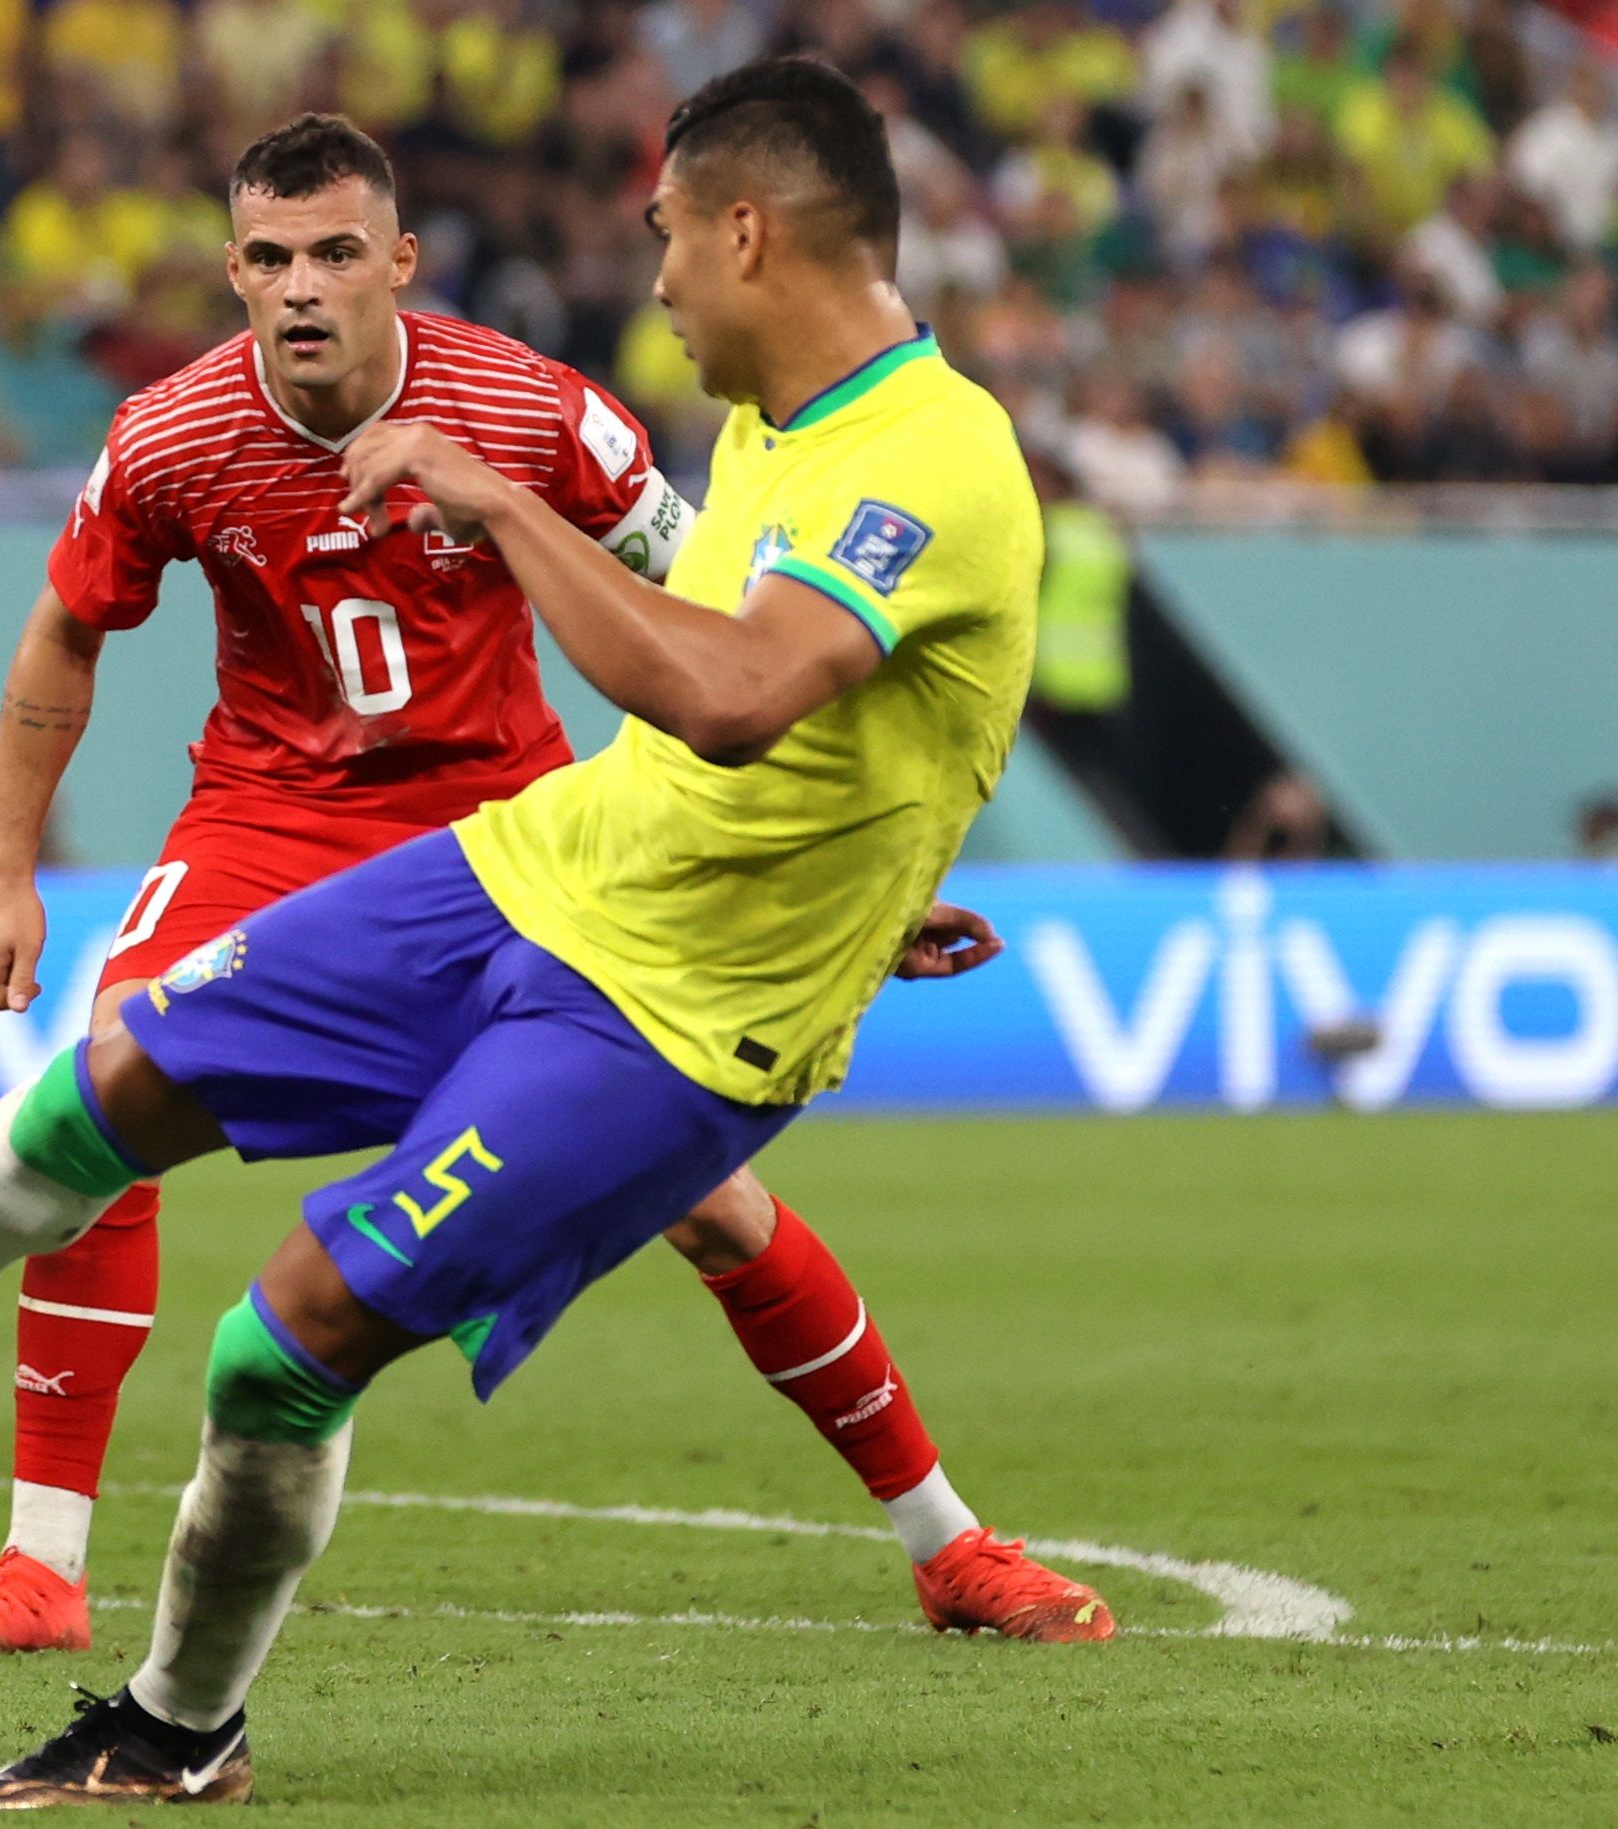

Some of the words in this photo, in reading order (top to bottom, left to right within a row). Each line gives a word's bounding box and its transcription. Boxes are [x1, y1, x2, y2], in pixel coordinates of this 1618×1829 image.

[306, 530, 360, 553] PUMA
[300, 598, 413, 716] 10
[1022, 870, 1618, 1111] vivo
[392, 1125, 503, 1239] 5
